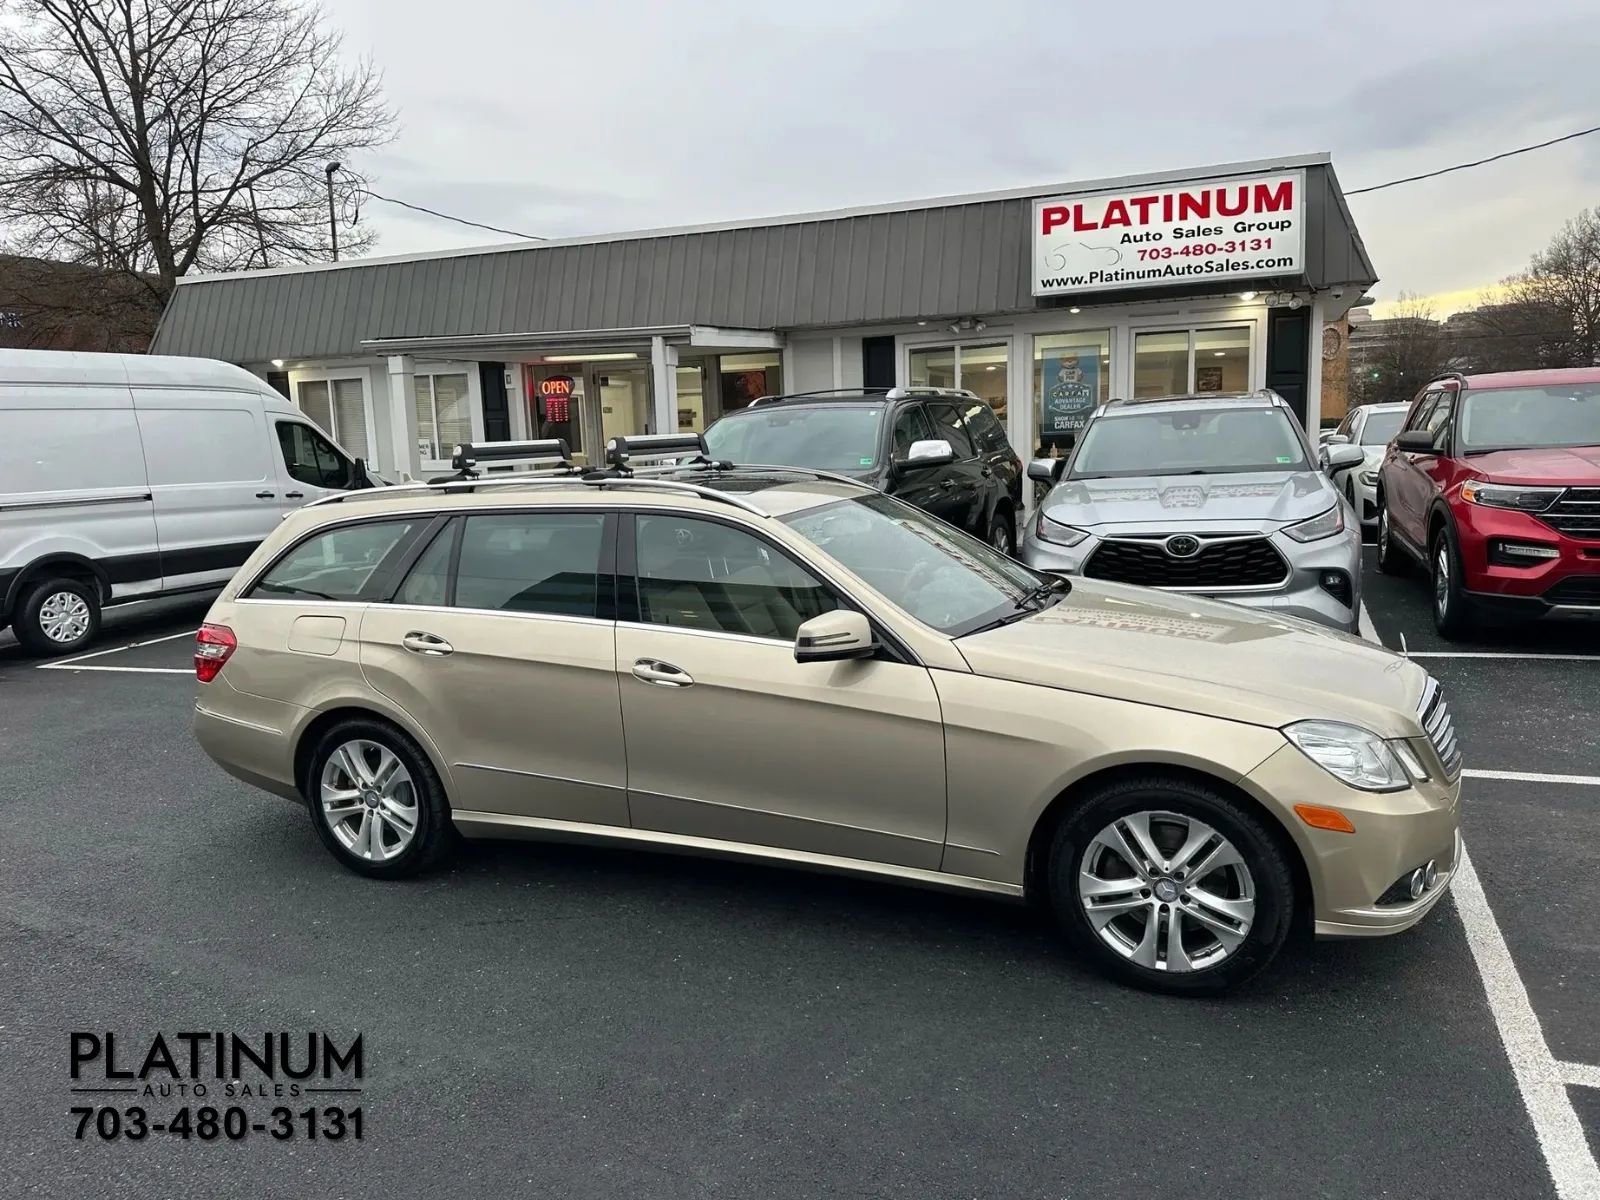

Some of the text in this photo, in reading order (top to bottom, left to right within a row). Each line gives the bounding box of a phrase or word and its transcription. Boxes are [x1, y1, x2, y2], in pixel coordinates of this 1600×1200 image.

[1042, 181, 1293, 236] PLATINUM
[1120, 218, 1293, 245] Auto Sales Group
[1137, 237, 1273, 262] 703-480-3131
[1041, 255, 1294, 288] www.PlatinumAutoSales.com
[542, 380, 570, 394] OPEN
[1054, 421, 1084, 429] CARFAX
